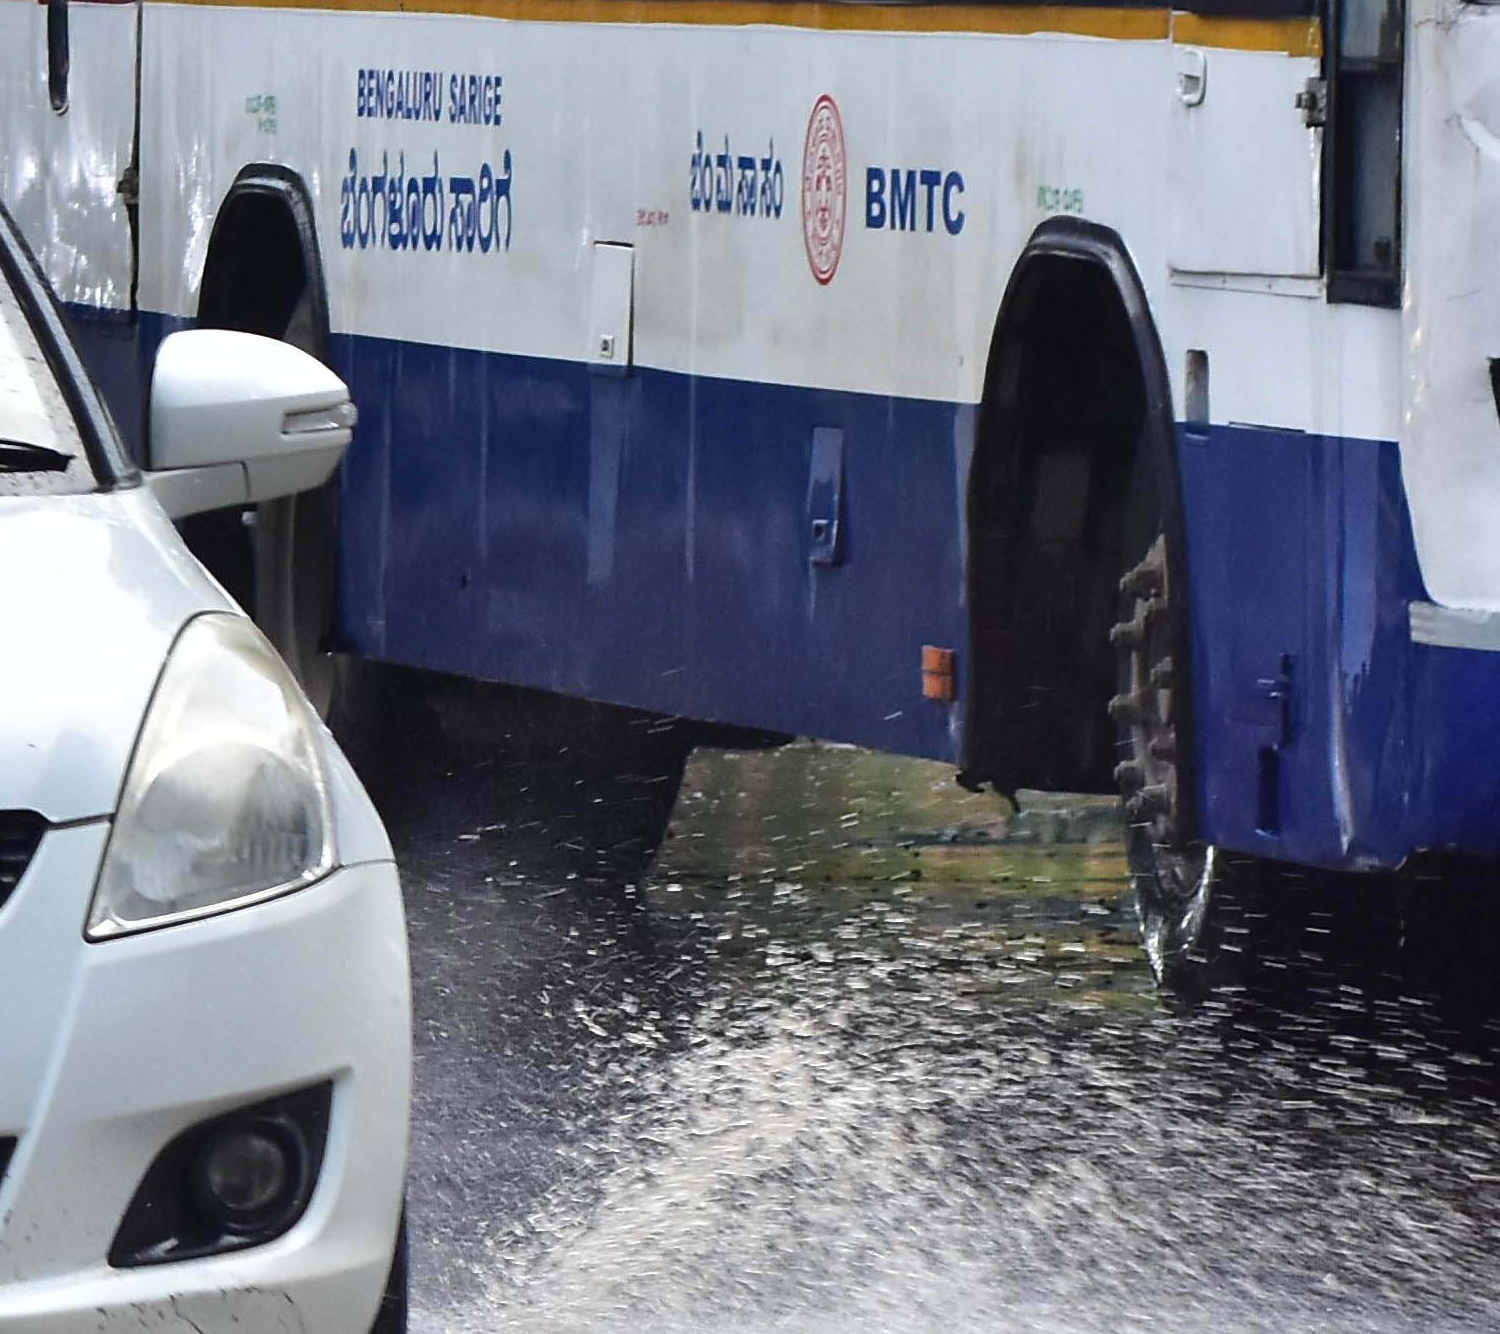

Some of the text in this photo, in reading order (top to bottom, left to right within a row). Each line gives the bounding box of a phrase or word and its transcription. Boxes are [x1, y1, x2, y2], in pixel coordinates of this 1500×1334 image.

[357, 68, 503, 127] BENGALURU SARIGE
[340, 147, 512, 254] ಬೆಂಗಳೂರು ಸಾರಿಗೆ
[865, 166, 966, 236] BMTC
